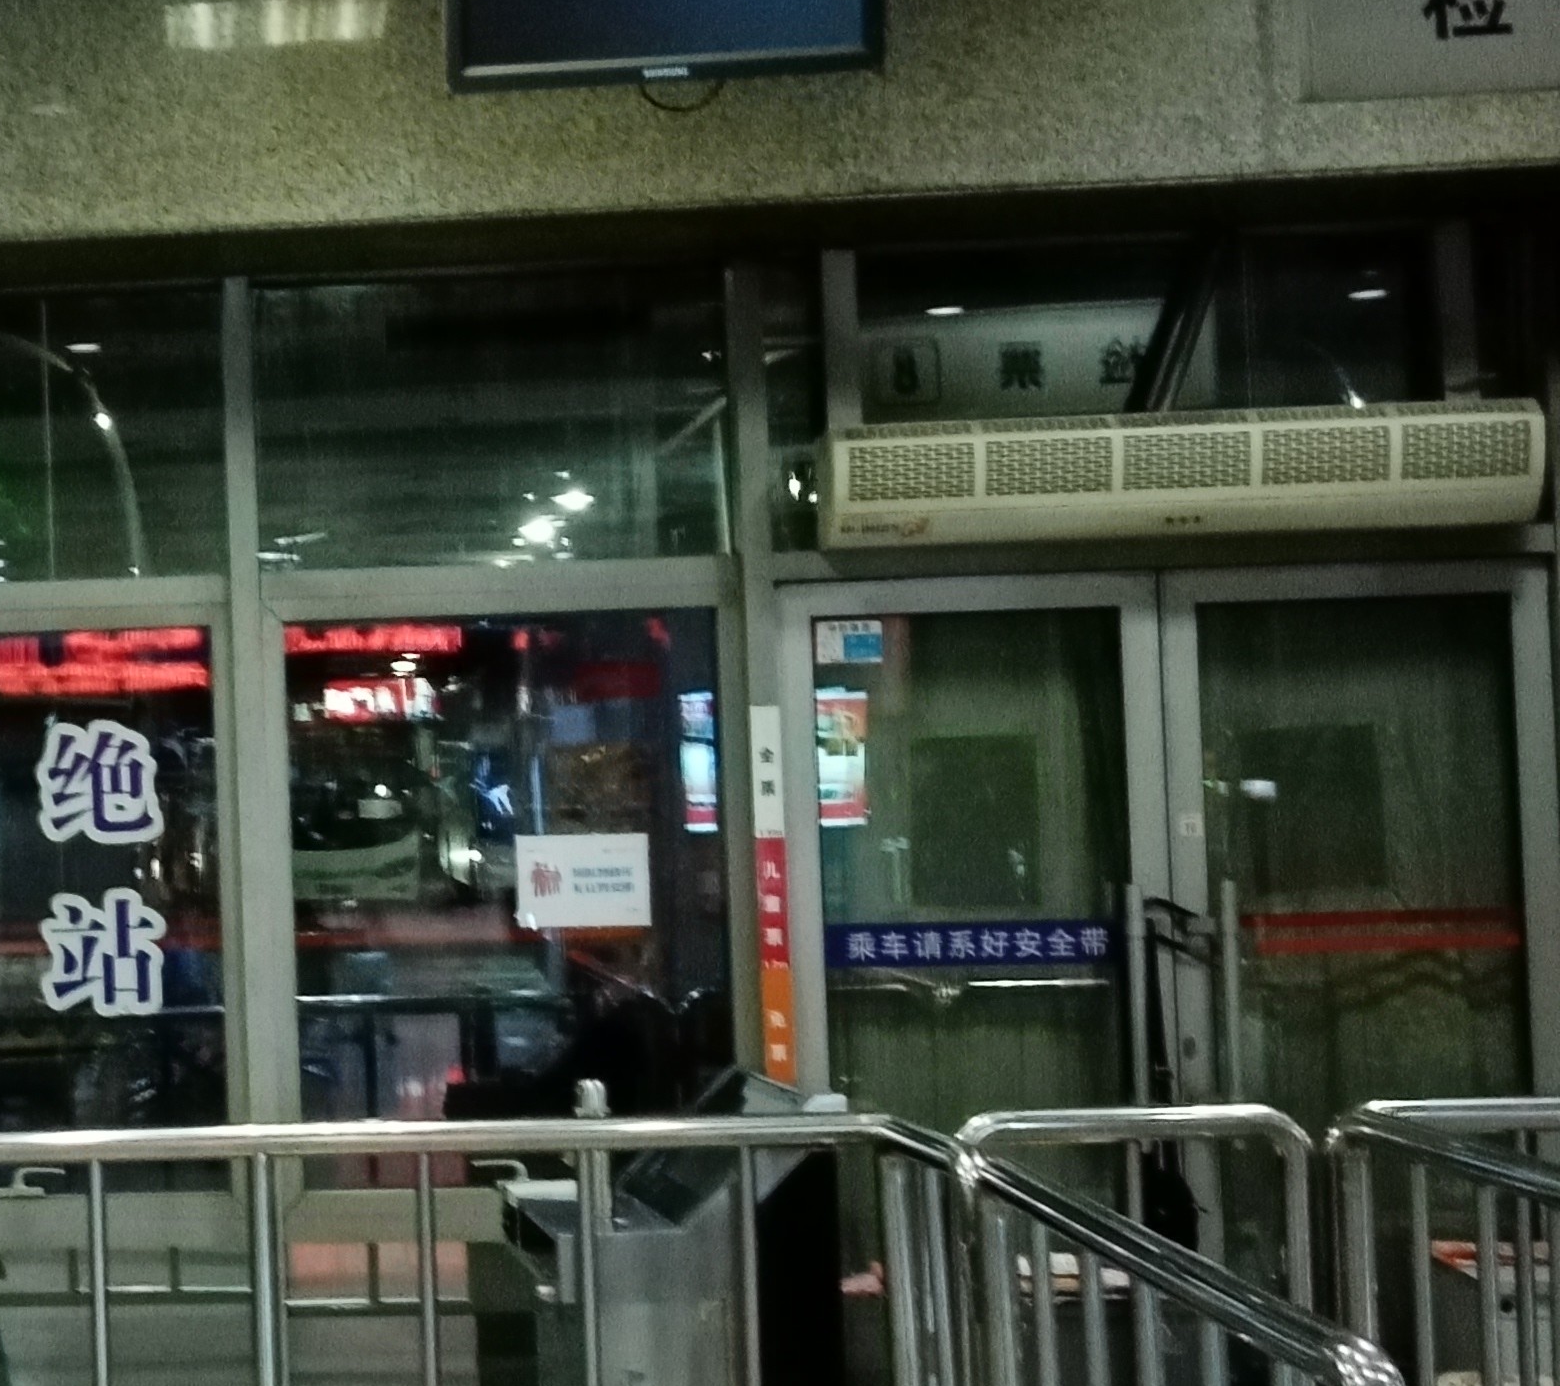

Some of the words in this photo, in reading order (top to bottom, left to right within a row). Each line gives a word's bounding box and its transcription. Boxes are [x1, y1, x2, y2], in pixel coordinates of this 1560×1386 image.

[845, 926, 1109, 962] 乘车请系好安全带
